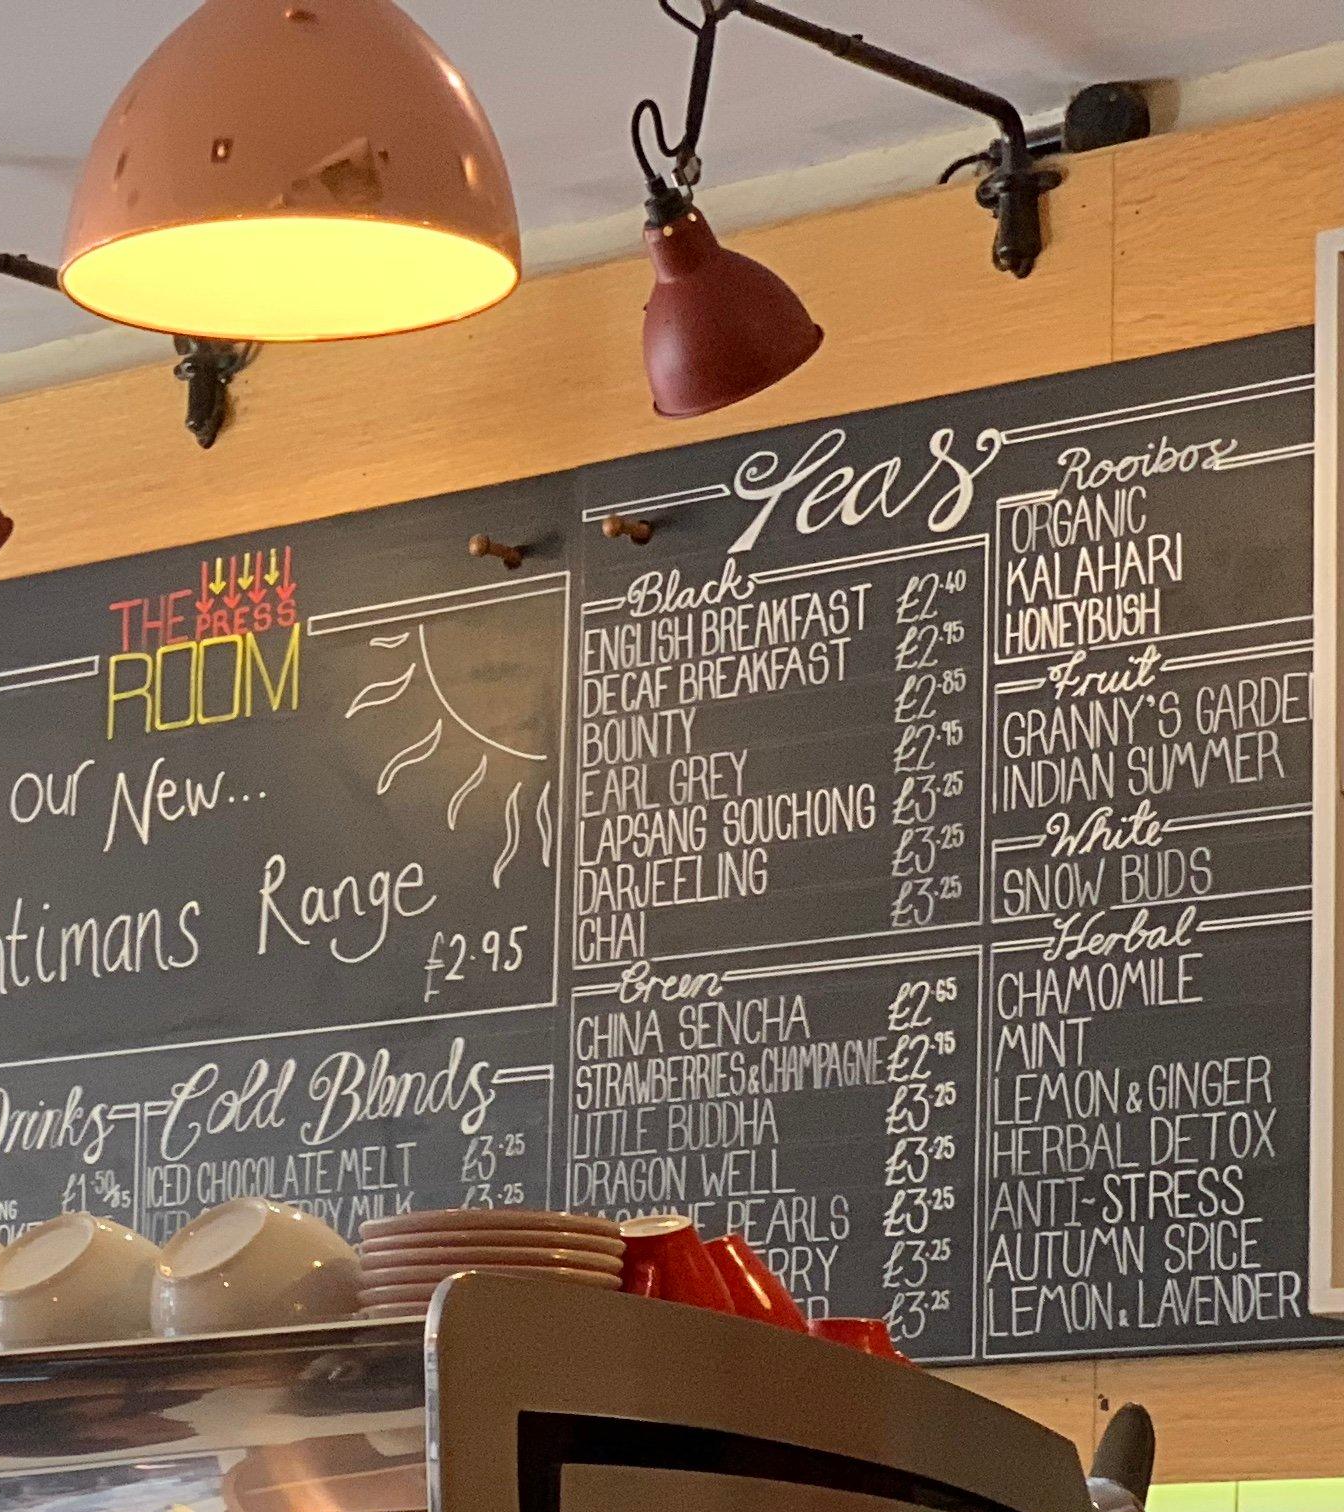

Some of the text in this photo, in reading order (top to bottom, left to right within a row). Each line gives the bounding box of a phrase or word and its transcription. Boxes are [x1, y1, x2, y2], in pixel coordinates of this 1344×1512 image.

[726, 427, 1003, 554] Teas
[1057, 437, 1238, 493] Rooibos
[1011, 486, 1146, 554] ORGANIC
[627, 558, 755, 617] Black
[1007, 533, 1182, 606] KALAHARI
[109, 589, 298, 652] THE PRESS
[583, 583, 872, 677] ENGLISH BREAKFAST
[1006, 589, 1160, 655] HONEYBUSH
[106, 622, 300, 740] ROOM
[583, 639, 851, 718] DECAF BREAKFAST
[1048, 644, 1162, 699] Fruit
[582, 708, 697, 767] BOUNTY
[1003, 691, 1182, 758] GRANNY'S
[10, 759, 95, 823] our
[581, 749, 747, 817] EARL GREY
[1003, 730, 1285, 812] INDIAN SUMMER
[579, 783, 875, 867] LAPSANG SOUCHONG
[1046, 799, 1163, 858] White
[258, 855, 437, 963] Range
[578, 848, 767, 916] DARJEELING
[1003, 847, 1212, 916] SNOW BUDS
[578, 912, 645, 962] CHAI
[1043, 905, 1197, 961] Herbal
[616, 960, 723, 1003] Green
[997, 953, 1203, 1020] CHAMOMILE
[577, 995, 810, 1061] CHINA SENCHA
[995, 1017, 1092, 1073] MINT
[162, 1037, 496, 1160] Cold Blends
[994, 1055, 1272, 1124] LEMON & GINGER
[574, 1098, 779, 1160] LITTLE BUDDHA
[993, 1107, 1277, 1178] HERBAL DETOX
[197, 1150, 334, 1204] CHOCOLATE
[338, 1143, 416, 1192] MELT
[573, 1149, 795, 1205] DRAGON WELL
[727, 1196, 849, 1245] PEARLS
[986, 1218, 1263, 1282] AUTUMN SPICE
[989, 1271, 1301, 1337] LEMON LAVENDER
